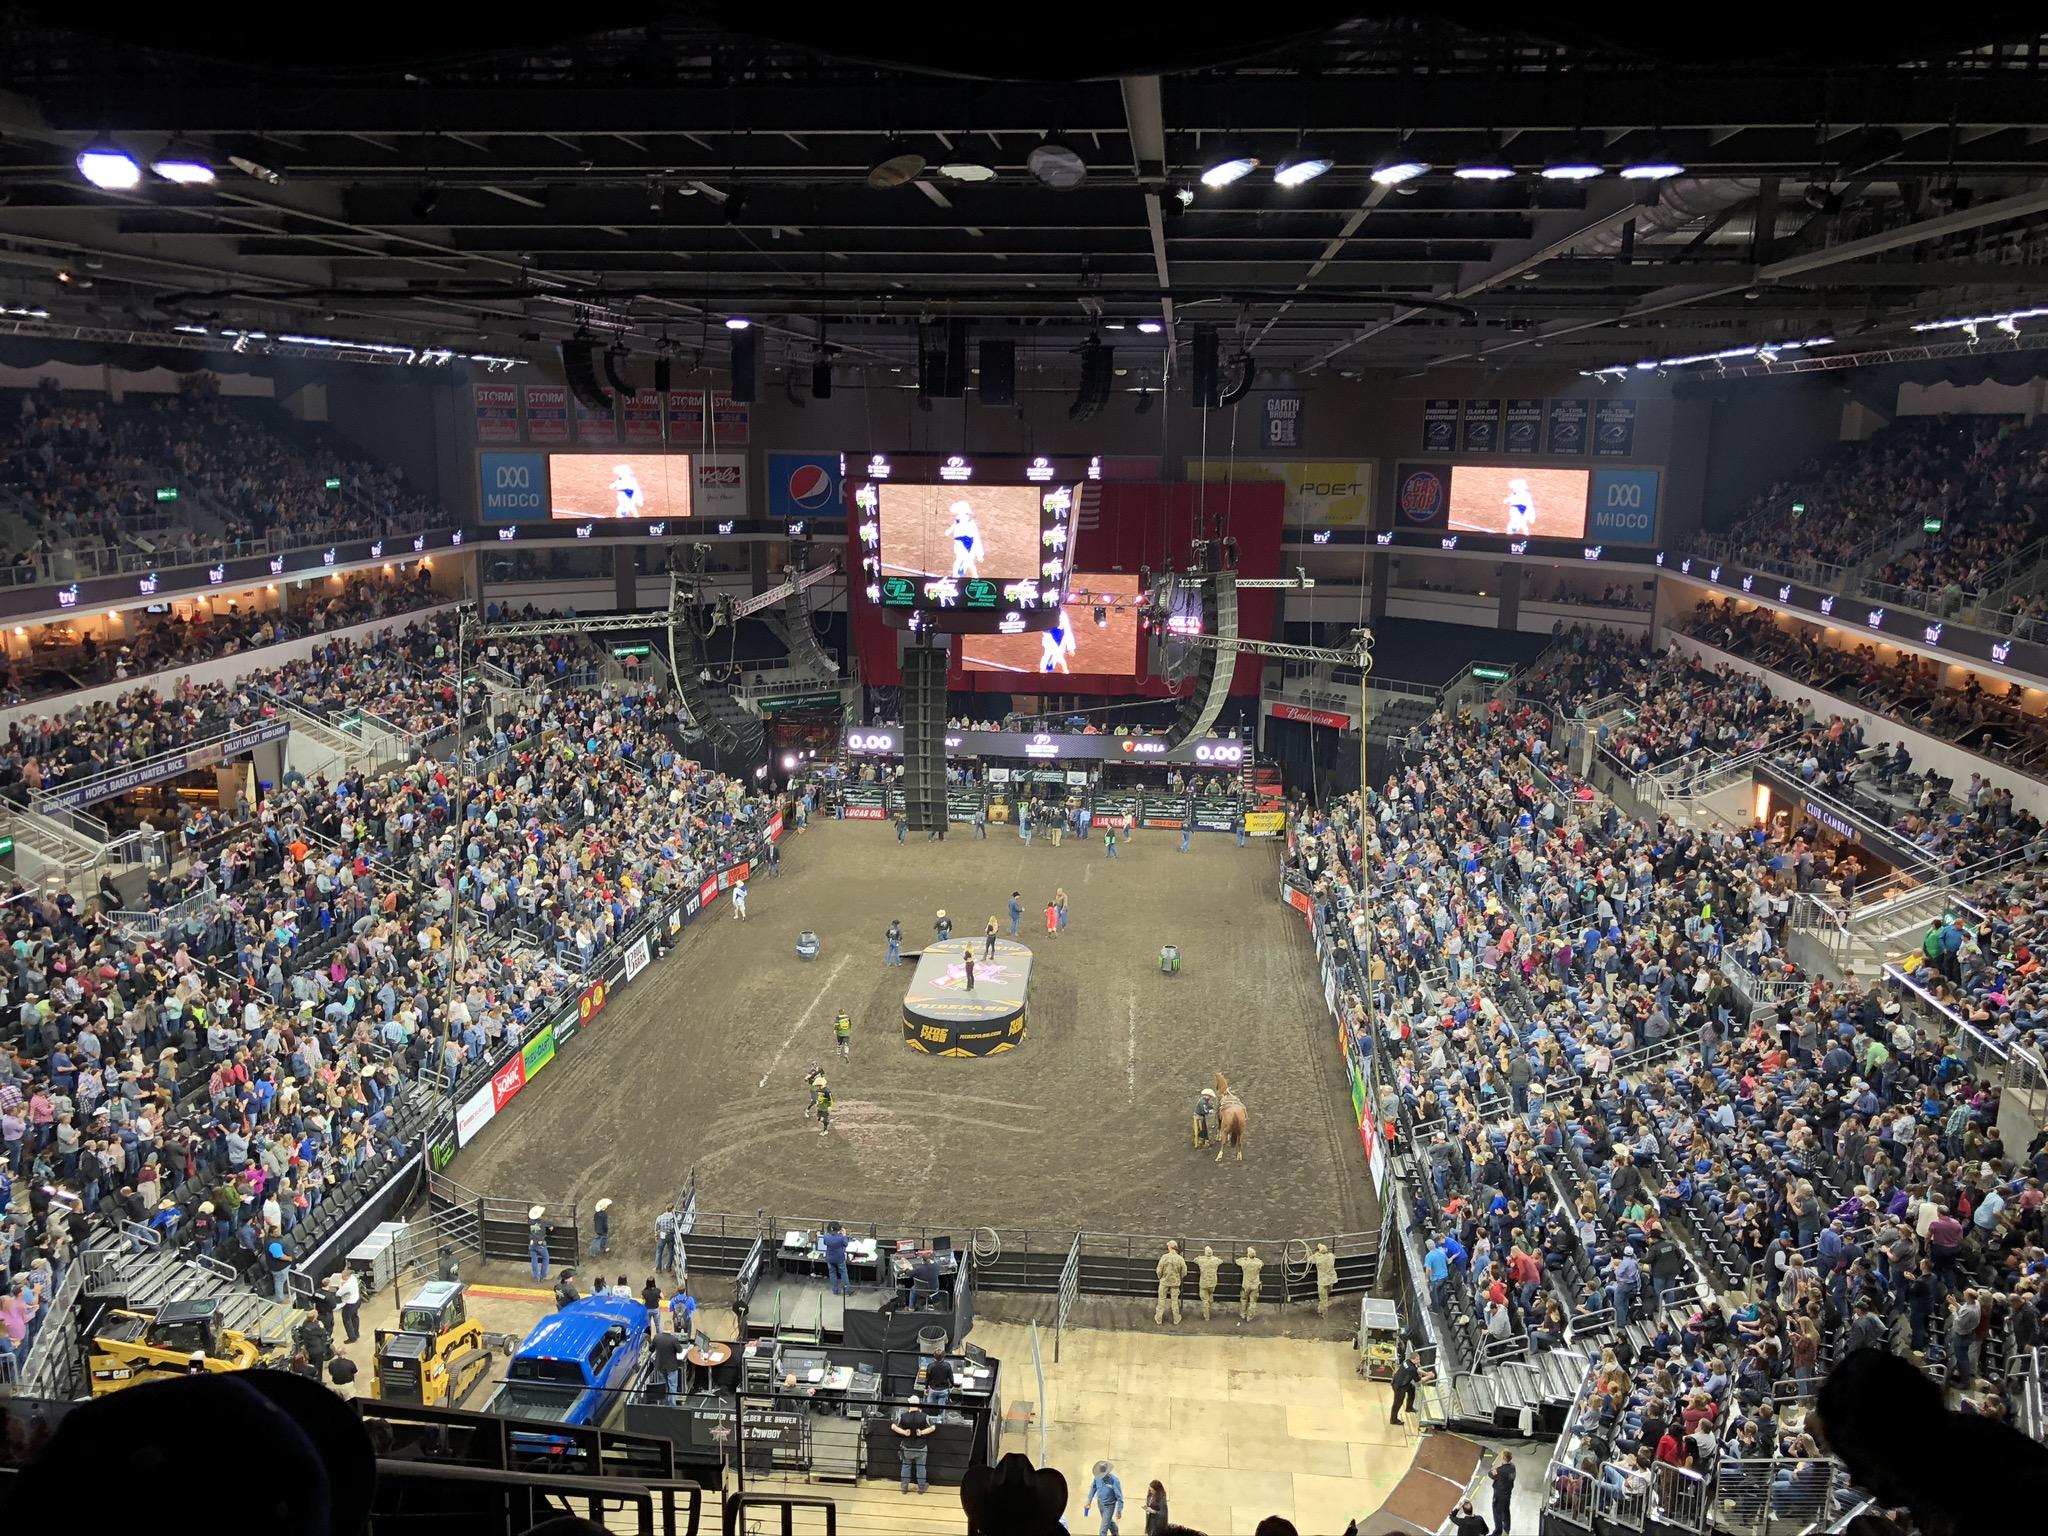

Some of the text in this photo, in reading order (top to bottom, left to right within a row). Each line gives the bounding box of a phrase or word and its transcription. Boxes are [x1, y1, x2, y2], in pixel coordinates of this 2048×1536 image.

[477, 391, 514, 402] STORM
[528, 392, 564, 403] STORM
[671, 396, 703, 407] STORM
[1267, 398, 1299, 411] GARTH
[1270, 419, 1281, 441] 9
[1299, 483, 1363, 496] POET
[1413, 478, 1440, 495] GAS
[488, 493, 540, 508] MIDCO
[1402, 493, 1436, 510] STOP
[1596, 511, 1648, 529] MIDCO
[499, 528, 514, 538] tru
[576, 527, 590, 537] tru
[649, 523, 665, 533] tru
[718, 523, 732, 533] tru
[1313, 533, 1328, 542] tru
[1376, 534, 1390, 543] tru
[1441, 539, 1454, 548] tru
[1510, 543, 1524, 552] tru
[1585, 548, 1599, 558] tru
[209, 569, 223, 581] tru
[140, 579, 155, 591] tru
[59, 590, 76, 603] tru
[1286, 705, 1335, 726] Budweiser
[223, 738, 242, 754] DILLY!
[242, 733, 260, 749] DILLY!
[272, 725, 287, 739] LIGHT
[849, 735, 892, 750] 0.00
[1134, 743, 1166, 753] ARIA
[1196, 745, 1242, 761] 0.00
[58, 792, 81, 807] LIGHT
[85, 785, 110, 800] HOPS.
[109, 774, 141, 793] BARLEY.
[140, 766, 167, 785] WATER.
[167, 758, 185, 776] RICE.
[845, 809, 882, 818] LUCAS OIL
[1096, 817, 1109, 825] LAS
[1806, 801, 1853, 839] CLUB CAMBRIA
[686, 894, 700, 916] YETI
[915, 1003, 1009, 1012] RIDEPASS
[920, 1024, 949, 1035] RIDE
[959, 1030, 1002, 1040] RIDEPASS.COM
[920, 1030, 948, 1043] PASS
[497, 1065, 520, 1099] SONIC
[392, 1360, 404, 1369] CAT
[112, 1369, 130, 1380] CAT
[693, 1411, 702, 1419] BE
[743, 1415, 762, 1423] OLDER
[751, 1427, 782, 1439] COWBOY
